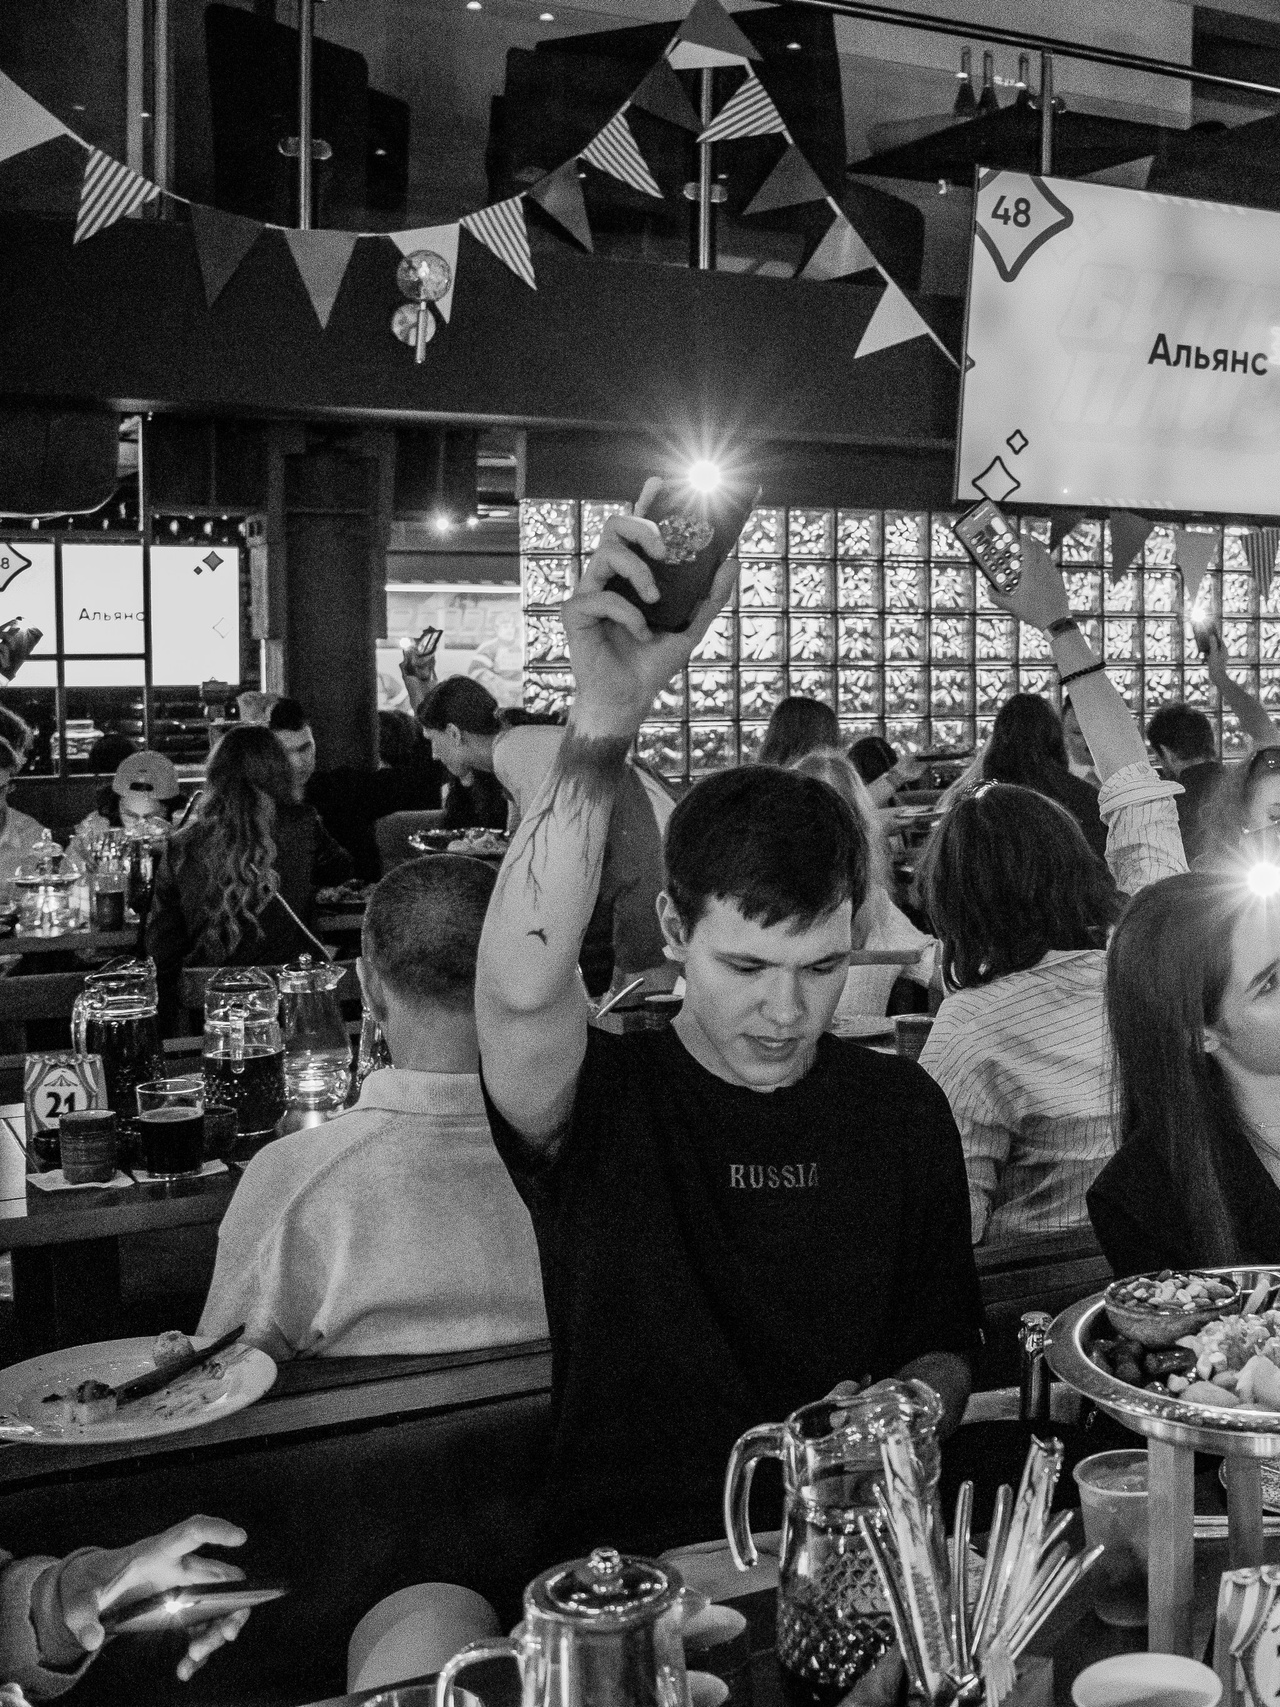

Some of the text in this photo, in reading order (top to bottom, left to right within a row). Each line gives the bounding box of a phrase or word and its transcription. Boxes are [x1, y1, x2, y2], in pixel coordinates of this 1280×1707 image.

[991, 195, 1031, 228] 48
[1148, 333, 1268, 376] Альянс
[0, 557, 10, 570] 8
[46, 1091, 76, 1118] 21
[729, 1163, 818, 1189] RUSSIA
